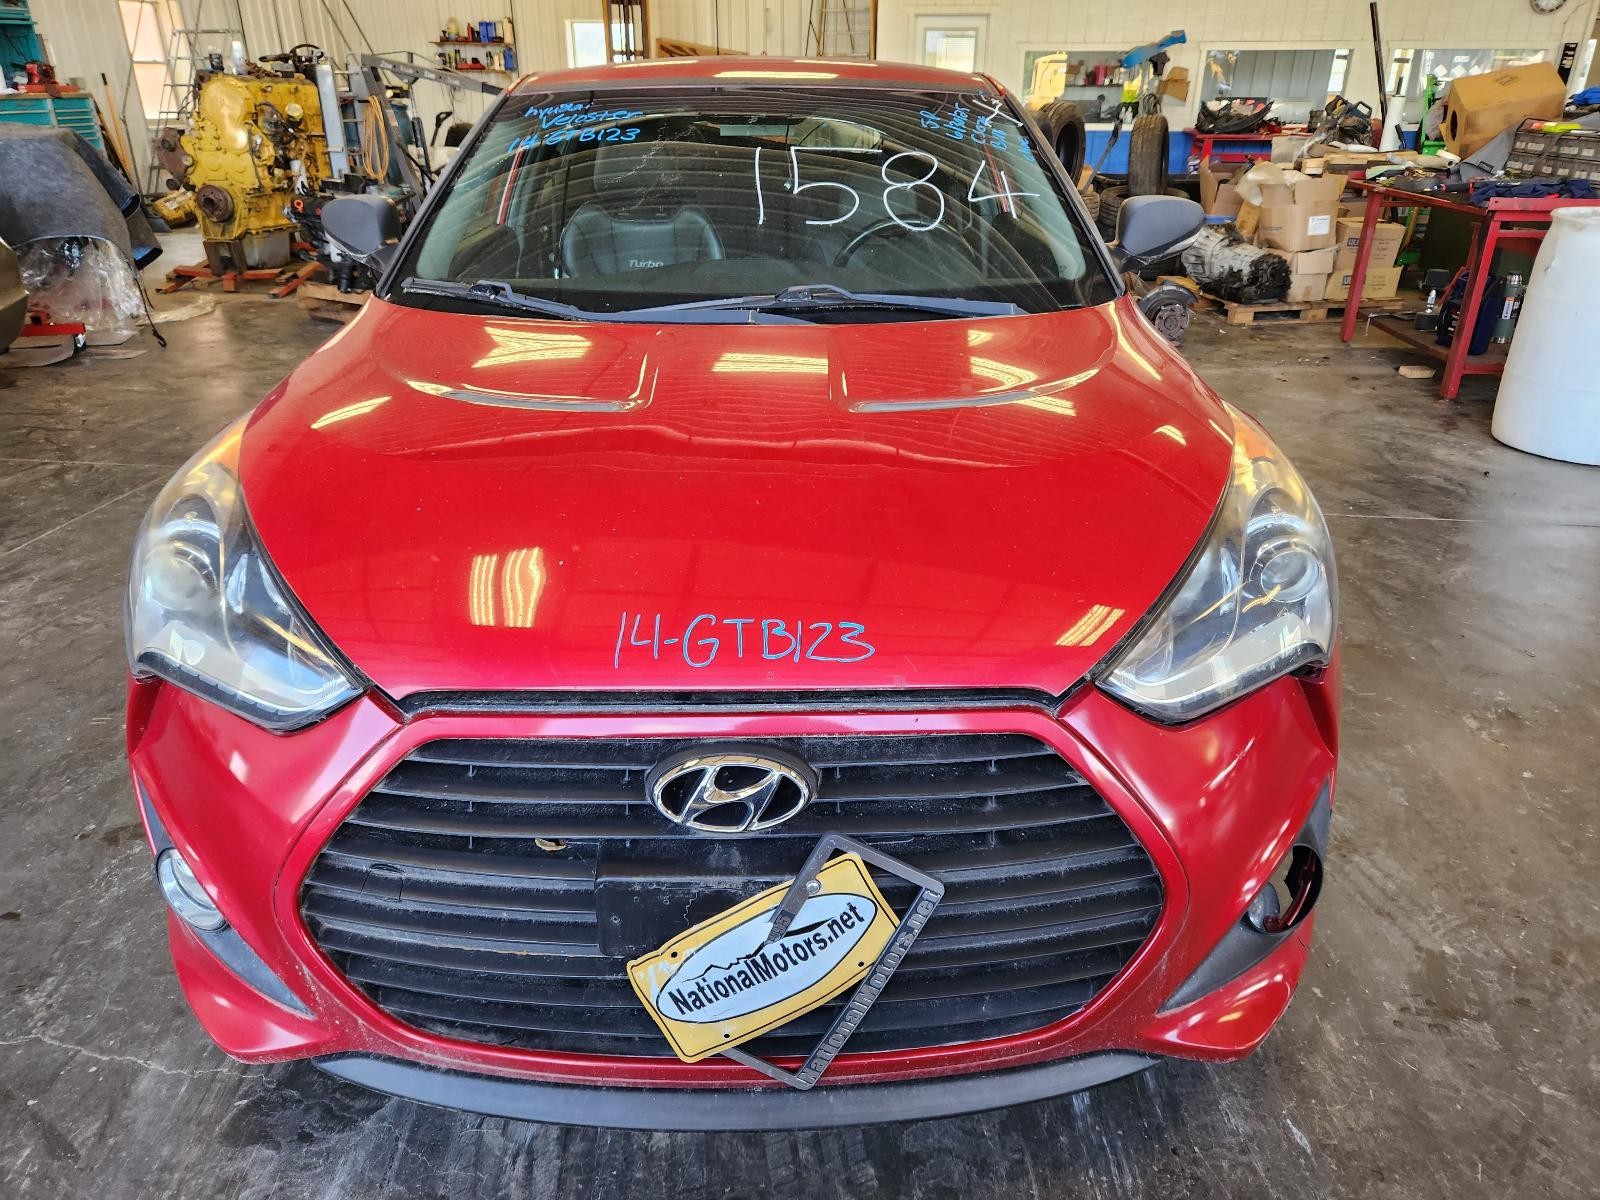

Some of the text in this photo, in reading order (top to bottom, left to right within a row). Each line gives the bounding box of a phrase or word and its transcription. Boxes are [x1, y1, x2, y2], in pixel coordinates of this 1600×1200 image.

[754, 146, 1041, 231] 1584
[628, 259, 665, 268] Turbo
[614, 611, 876, 669] 14-GTB123
[667, 901, 866, 1016] NationalMotors.net
[799, 889, 943, 1085] NationalMotors.net
